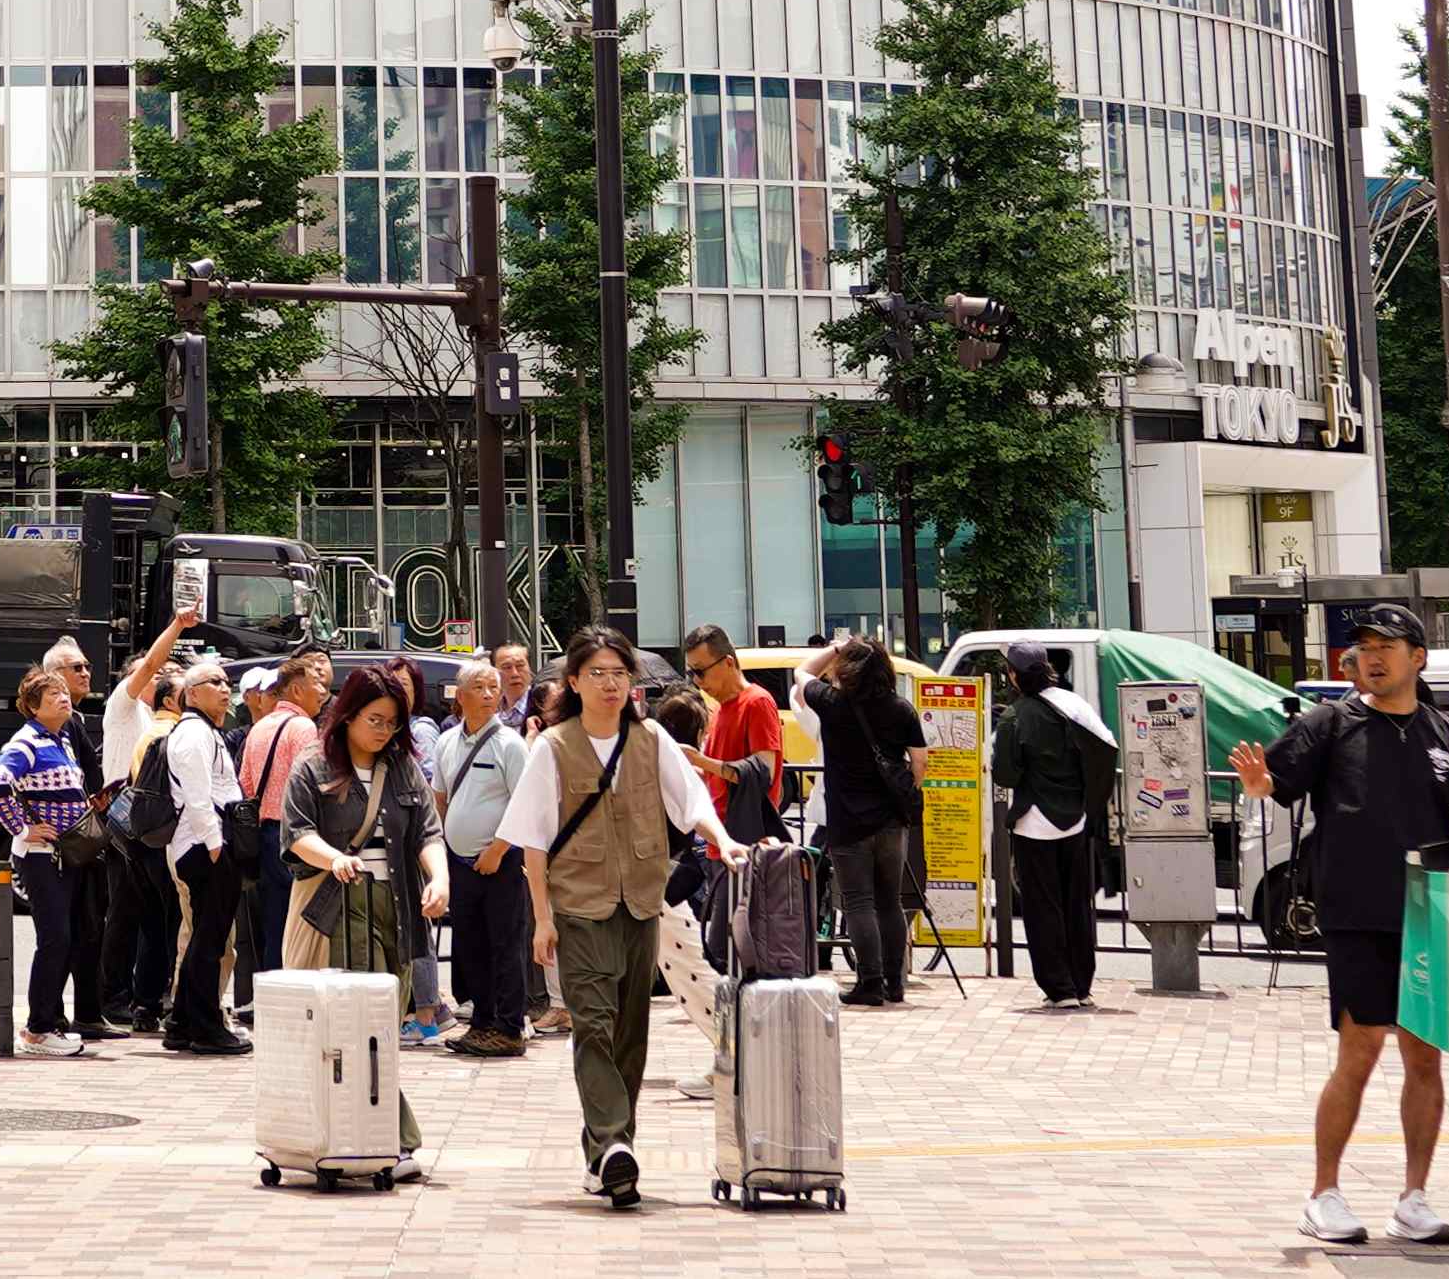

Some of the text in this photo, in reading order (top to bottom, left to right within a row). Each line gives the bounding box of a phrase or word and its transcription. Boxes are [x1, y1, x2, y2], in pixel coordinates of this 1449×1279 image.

[1194, 307, 1297, 377] Alpen
[1196, 383, 1300, 444] TOKYO
[1280, 507, 1293, 519] 9F
